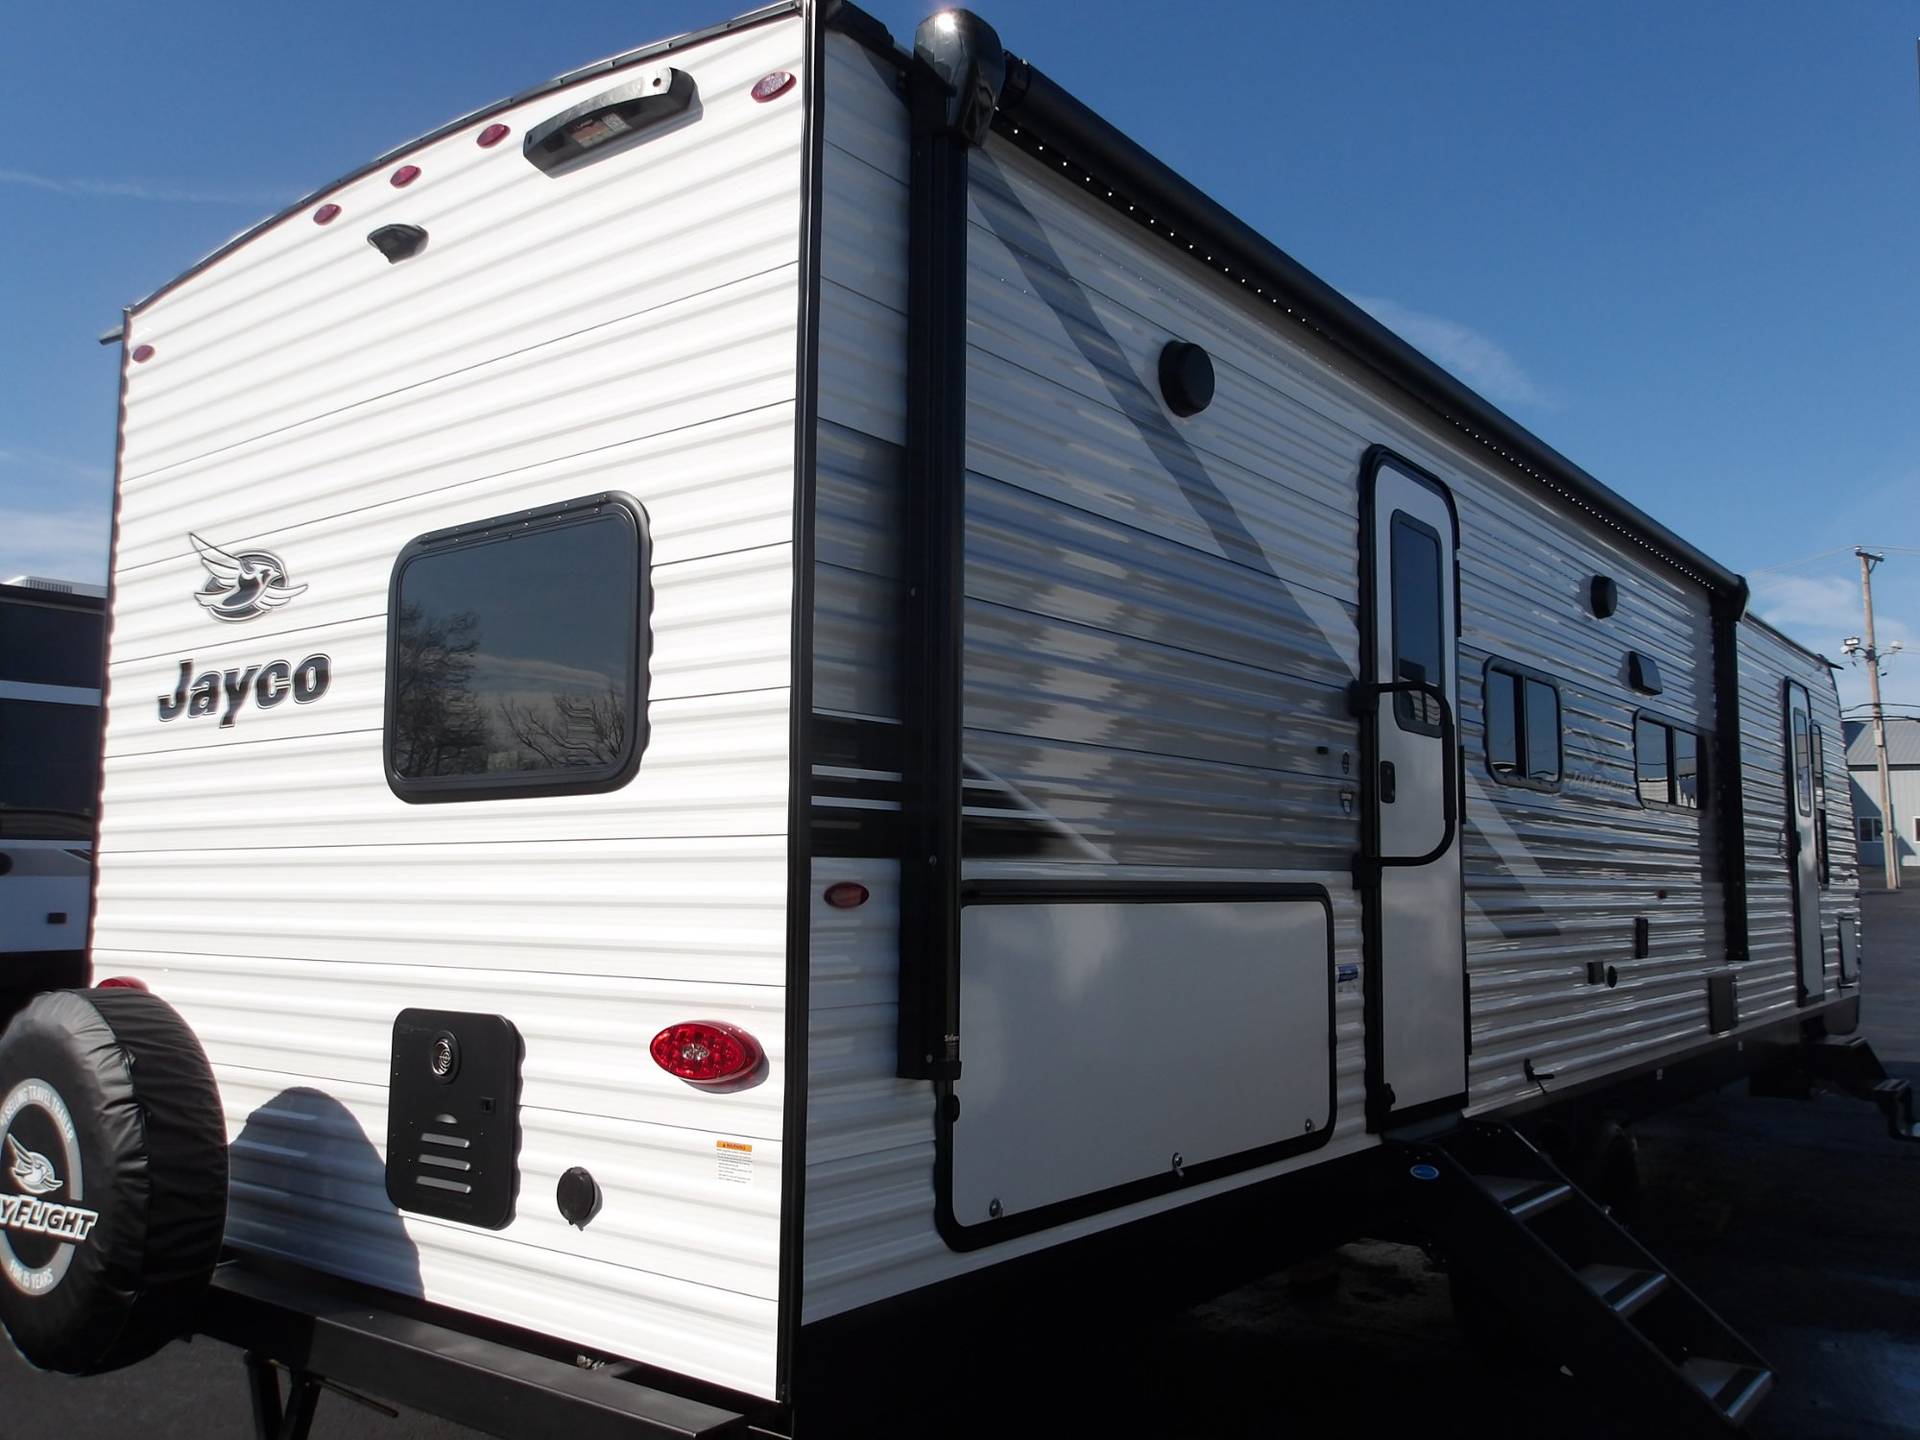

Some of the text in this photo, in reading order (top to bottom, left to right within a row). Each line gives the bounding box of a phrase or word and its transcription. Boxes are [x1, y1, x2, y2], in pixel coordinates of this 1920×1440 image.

[158, 653, 331, 728] Jayco
[28, 1084, 51, 1108] TRAVEL
[31, 1267, 54, 1289] YEARS
